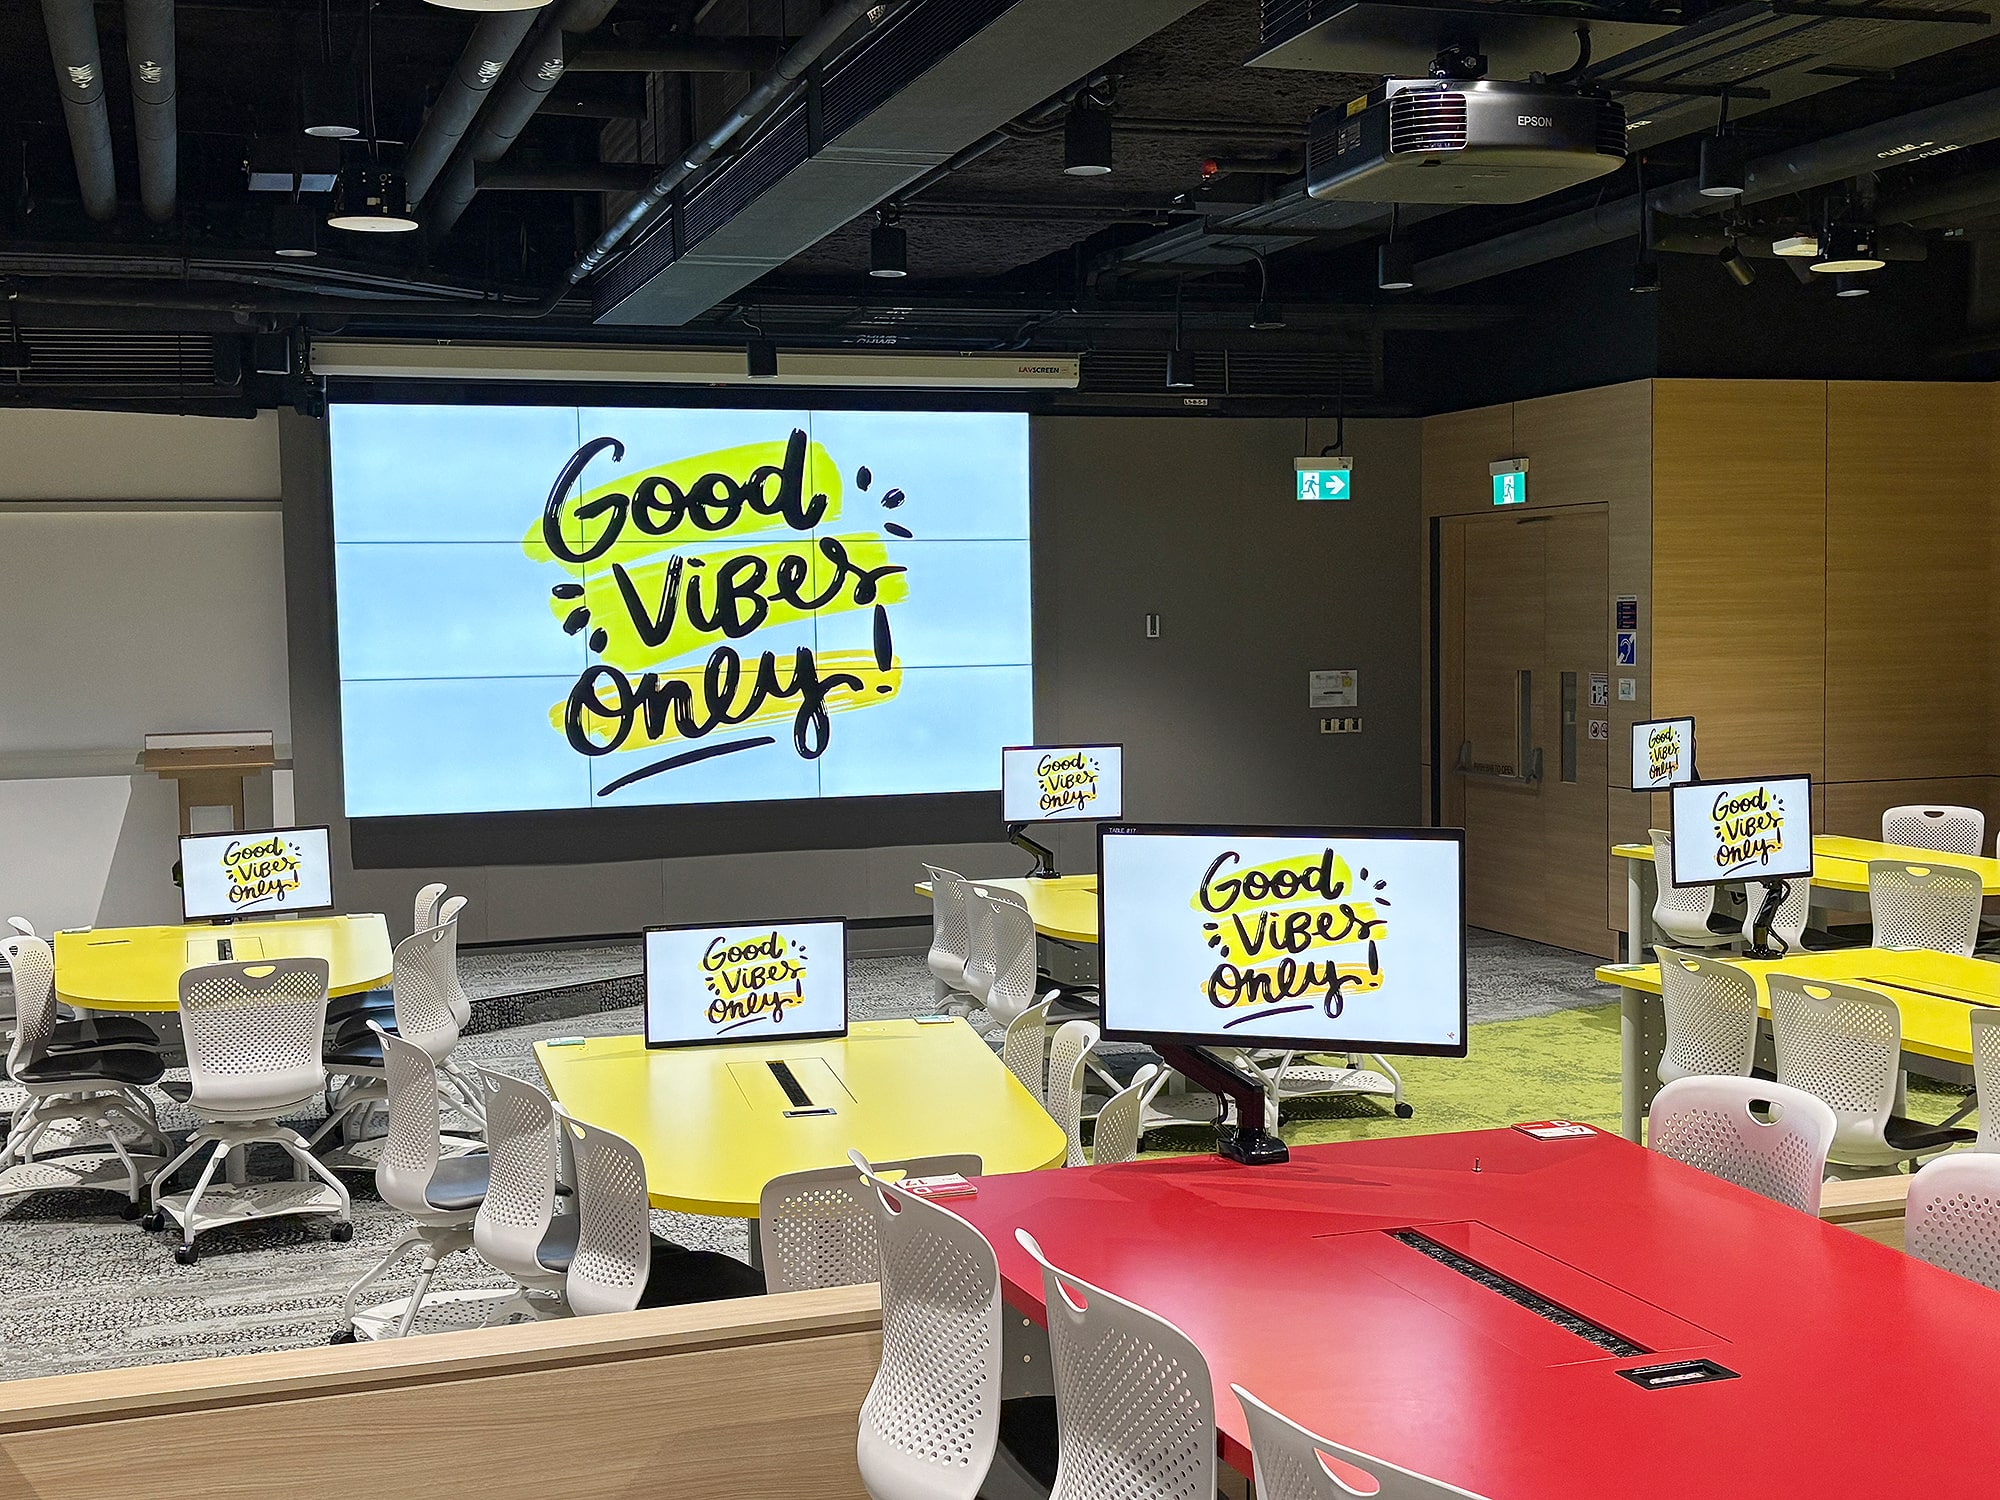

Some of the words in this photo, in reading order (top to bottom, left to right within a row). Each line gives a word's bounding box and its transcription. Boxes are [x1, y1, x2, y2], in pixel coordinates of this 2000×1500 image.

[1517, 115, 1553, 127] EPSON
[542, 428, 828, 564] Good
[1037, 752, 1086, 777] Good
[1712, 786, 1768, 822] Good
[223, 836, 284, 866] Good
[1199, 848, 1345, 913] Good
[703, 931, 783, 972] Good
